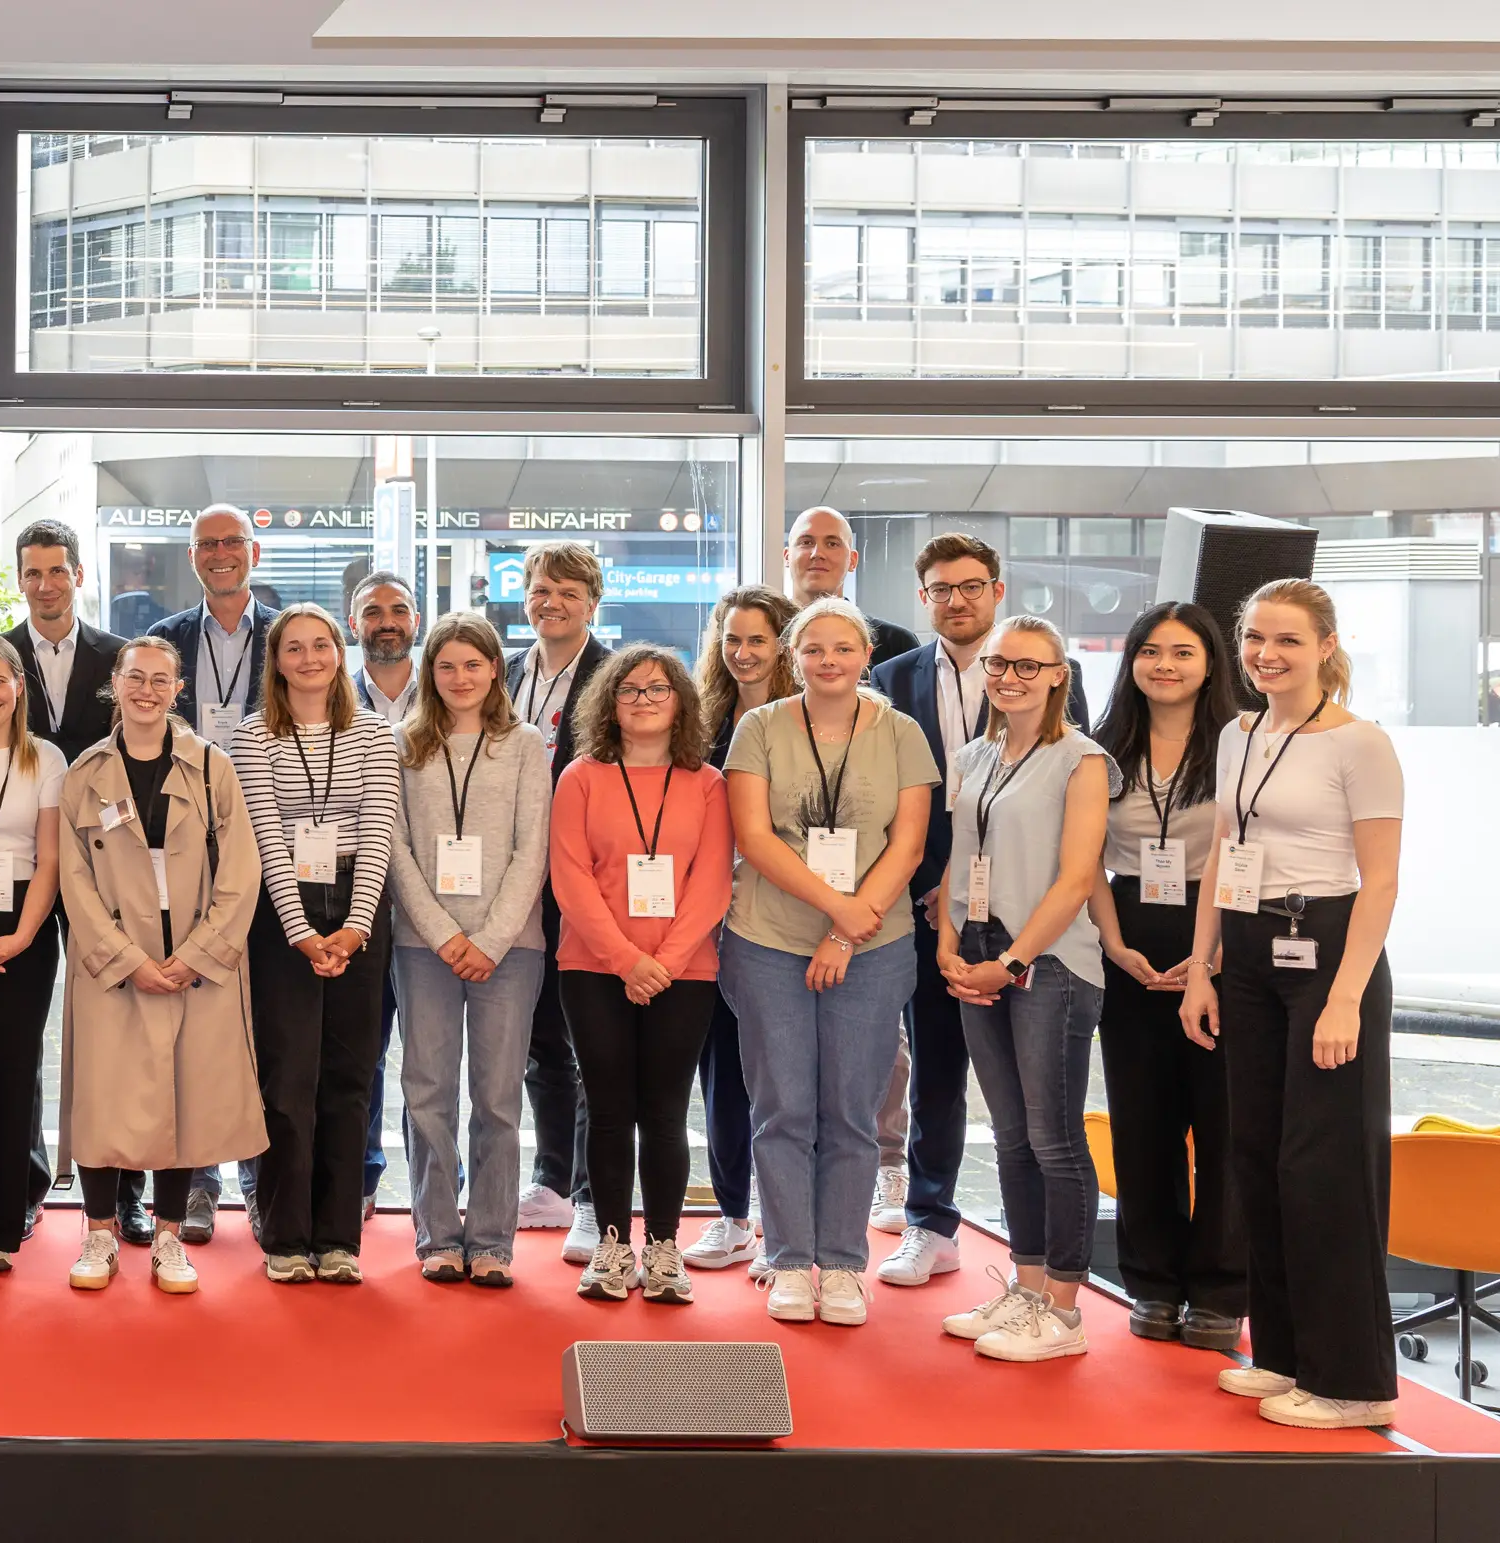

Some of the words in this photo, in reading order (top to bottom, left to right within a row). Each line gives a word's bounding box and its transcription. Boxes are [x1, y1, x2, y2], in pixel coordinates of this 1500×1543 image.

[509, 512, 632, 529] EINFAHRT
[501, 570, 523, 598] P
[607, 570, 680, 587] City-Garage
